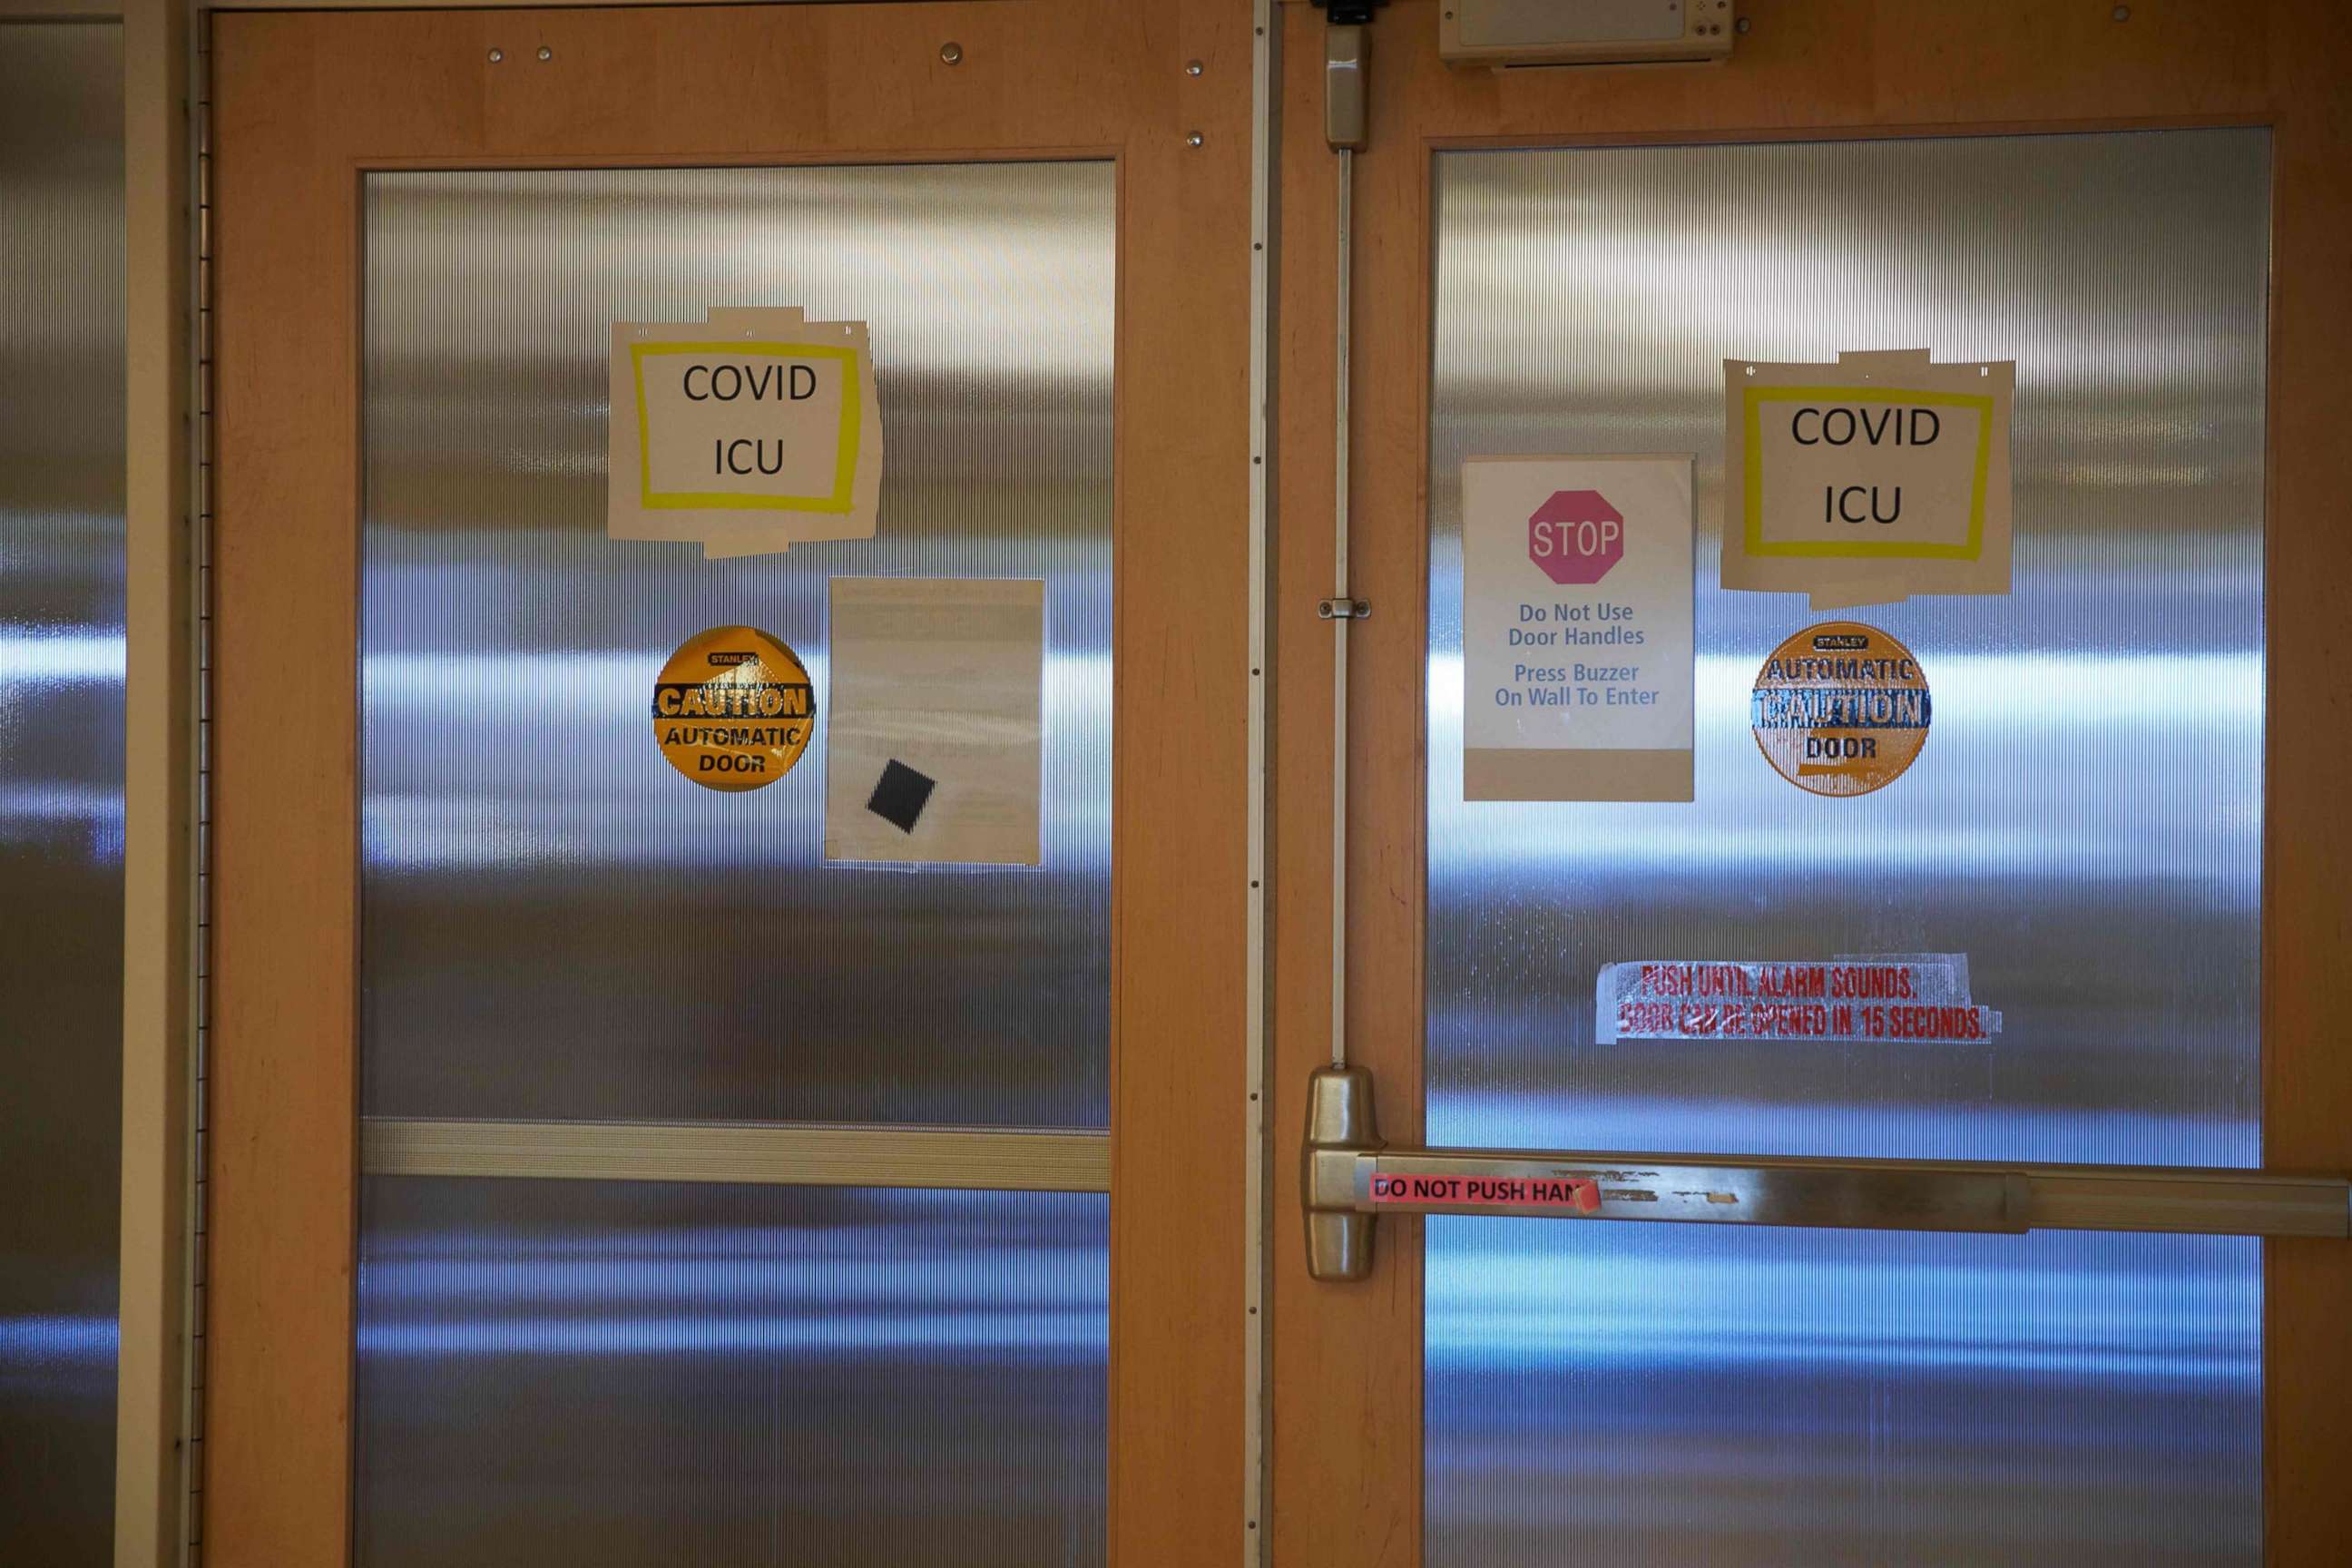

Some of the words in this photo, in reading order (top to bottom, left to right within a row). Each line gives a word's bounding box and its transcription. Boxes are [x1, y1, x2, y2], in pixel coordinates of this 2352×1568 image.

[682, 364, 817, 401] COVID
[1790, 407, 1941, 446] COVID
[715, 438, 784, 475] ICU
[1825, 485, 1902, 524] ICU
[1533, 520, 1620, 558] STOP
[1519, 603, 1547, 622] Do
[1554, 603, 1591, 622] Not
[1597, 603, 1634, 622] Use
[1508, 627, 1558, 646] Door
[1564, 625, 1645, 646] Handles
[1817, 635, 1867, 648] STANLEY
[710, 653, 758, 665] STANLEY
[1766, 657, 1914, 681] AUTOMATIC
[1514, 663, 1567, 682] Press
[1573, 663, 1640, 681] Buzzer
[657, 687, 808, 717] CAUTION
[1494, 687, 1523, 706] On
[1527, 686, 1572, 706] Wall
[1576, 687, 1598, 705] To
[1606, 687, 1660, 705] Enter
[1762, 691, 1922, 726] CAUTION
[664, 727, 801, 746] AUTOMATIC
[1806, 736, 1877, 760] DOOR
[699, 754, 766, 773] DOOR
[1641, 965, 1692, 997] PUSH
[1698, 965, 1752, 998] UNTIL
[1758, 965, 1826, 999] ALARM
[1831, 965, 1918, 1000] SOUNDS.
[1680, 1003, 1717, 1035] CAN
[1722, 1003, 1746, 1034] BE
[1751, 1004, 1827, 1035] OPENED
[1832, 1004, 1852, 1035] IN
[1862, 1005, 1885, 1037] 15
[1889, 1005, 1987, 1039] SECONDS.
[1374, 1178, 1406, 1198] DO
[1414, 1180, 1460, 1199] NOT
[1467, 1181, 1525, 1200] PUSH
